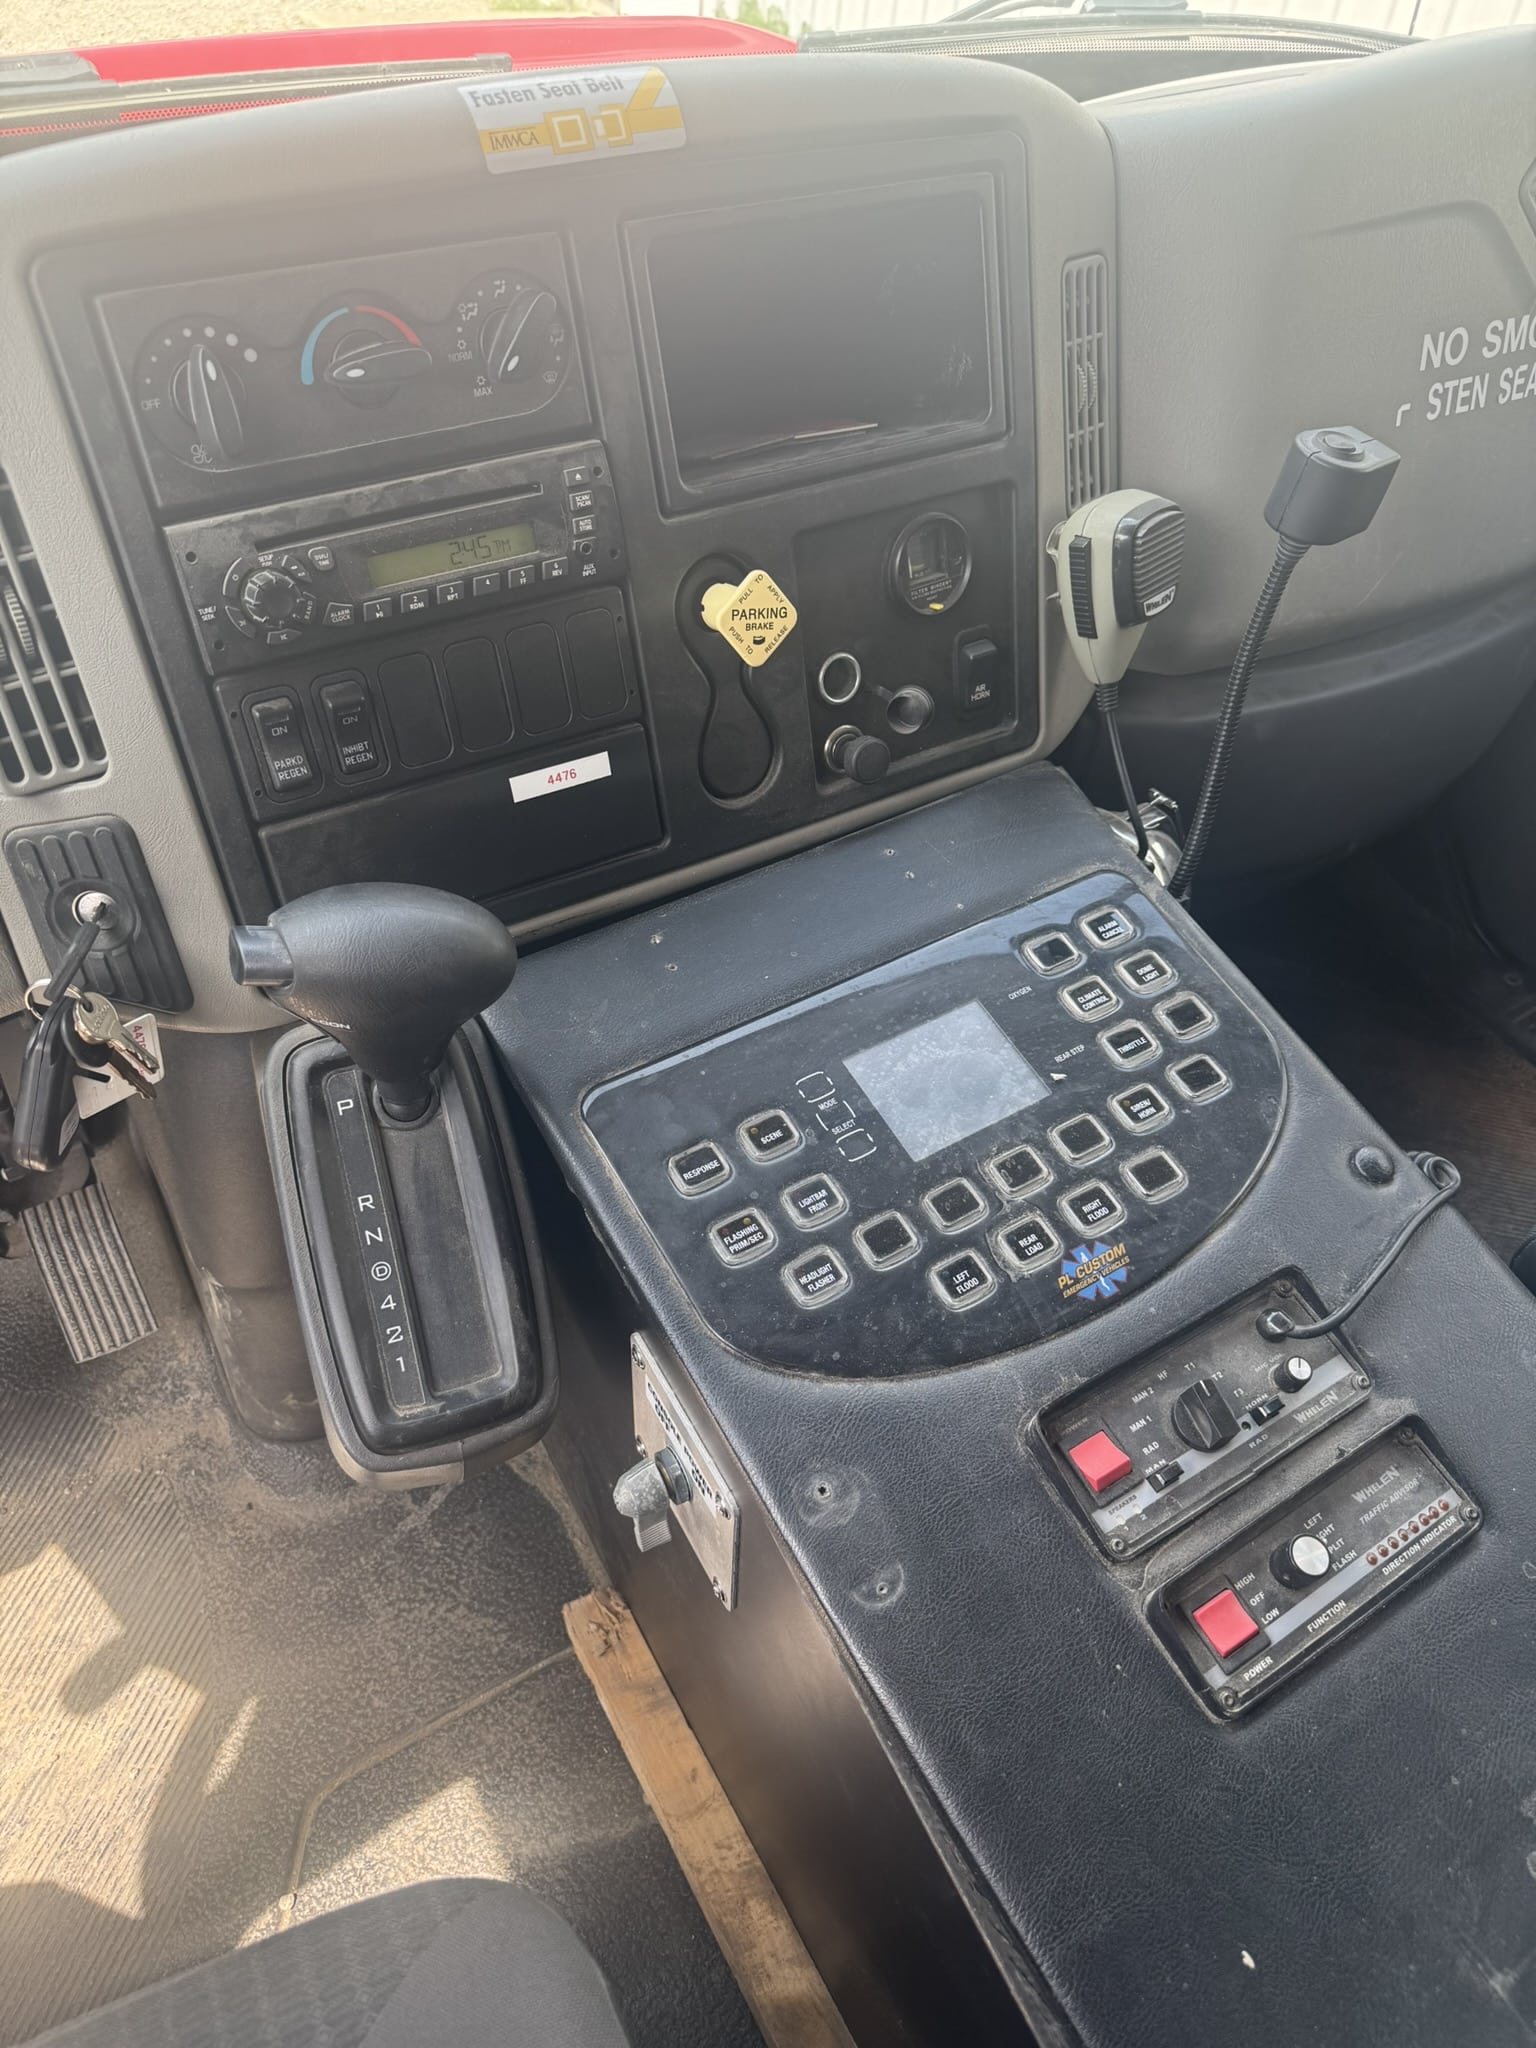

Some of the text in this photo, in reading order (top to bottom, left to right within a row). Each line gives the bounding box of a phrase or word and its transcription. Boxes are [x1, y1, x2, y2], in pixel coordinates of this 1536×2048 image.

[469, 75, 625, 108] Fasten Seat Belt
[488, 130, 540, 151] IMWCA
[1419, 326, 1469, 372] NO
[473, 385, 494, 398] MAX
[485, 577, 491, 585] 4
[551, 568, 563, 577] REV
[738, 573, 785, 605] PULL TO APPLY
[409, 602, 424, 610] RDM
[1145, 589, 1173, 613] WHELEN
[331, 614, 351, 623] CLOCK
[731, 606, 788, 622] PARKING
[745, 621, 774, 631] BRAKE
[728, 625, 788, 654] PUSH TO RELEASE
[970, 689, 991, 703] HORN
[975, 683, 987, 692] AIR
[342, 715, 359, 725] ON
[271, 725, 288, 737] ON
[342, 740, 369, 755] INHIBT
[274, 755, 304, 771] PARKD
[345, 752, 374, 766] REGEN
[278, 765, 308, 781] REGEN
[547, 768, 577, 785] 4476
[1097, 920, 1119, 933] ALARM
[1101, 926, 1125, 940] CANCEL
[1142, 970, 1160, 983] LIGHT
[1008, 985, 1033, 1001] OXYGEN
[1077, 988, 1103, 1004] CLIMATE
[1082, 995, 1110, 1011] CONTROL
[1054, 1044, 1086, 1064] REAR STEP
[1118, 1036, 1148, 1055] THROTTLE
[336, 1099, 354, 1116] P
[818, 1097, 839, 1112] MODE
[1137, 1105, 1157, 1120] HORN
[831, 1118, 857, 1136] SELECT
[760, 1128, 784, 1146] SCENE
[682, 1159, 721, 1181] RESPONSE
[357, 1194, 375, 1213] R
[798, 1189, 829, 1209] LIGHTBAR
[808, 1199, 830, 1215] FRONT
[1081, 1198, 1103, 1214] RIGHT
[1087, 1206, 1110, 1223] FLOOD
[364, 1227, 384, 1246] N
[723, 1222, 760, 1246] FLASHING
[1018, 1232, 1039, 1248] REAR
[728, 1232, 765, 1255] PRIM/SEC
[1024, 1241, 1045, 1257] LOAD
[373, 1263, 389, 1279] D
[798, 1262, 834, 1286] HEADLIGHT
[1058, 1243, 1127, 1289] PL CUSTOM
[807, 1273, 836, 1294] FLASHER
[952, 1269, 970, 1285] LEFT
[1062, 1255, 1131, 1299] EMERGENCY VEHICLES
[955, 1276, 980, 1296] FLOOD
[380, 1294, 397, 1311] 4
[386, 1325, 404, 1345] 2
[396, 1356, 406, 1373] 1
[1184, 1362, 1196, 1373] T1
[1156, 1369, 1168, 1382] HF
[1211, 1370, 1224, 1382] T2
[1131, 1386, 1155, 1405] MAN 2
[1292, 1390, 1339, 1424] WHELEN
[1128, 1415, 1153, 1433] MAN 1
[1142, 1440, 1160, 1456] RAD
[1248, 1433, 1270, 1449] RAD
[1145, 1458, 1167, 1475] MAN
[1350, 1464, 1401, 1504] WHELEN
[1107, 1494, 1138, 1516] SPEAKERS
[1359, 1477, 1420, 1527] TRAFFIC ADVISOR
[1303, 1511, 1324, 1531] LEFT
[1315, 1522, 1336, 1540] IGHT
[1328, 1537, 1346, 1555] PLIT
[1382, 1514, 1458, 1577] DIRECTION INDICATOR
[1331, 1549, 1358, 1572] FLASH
[1234, 1572, 1257, 1592] HIGH
[1249, 1591, 1266, 1608] OFF
[1261, 1607, 1280, 1625] LOW
[1306, 1599, 1347, 1633] FUNCTION
[1242, 1655, 1274, 1683] POWER
